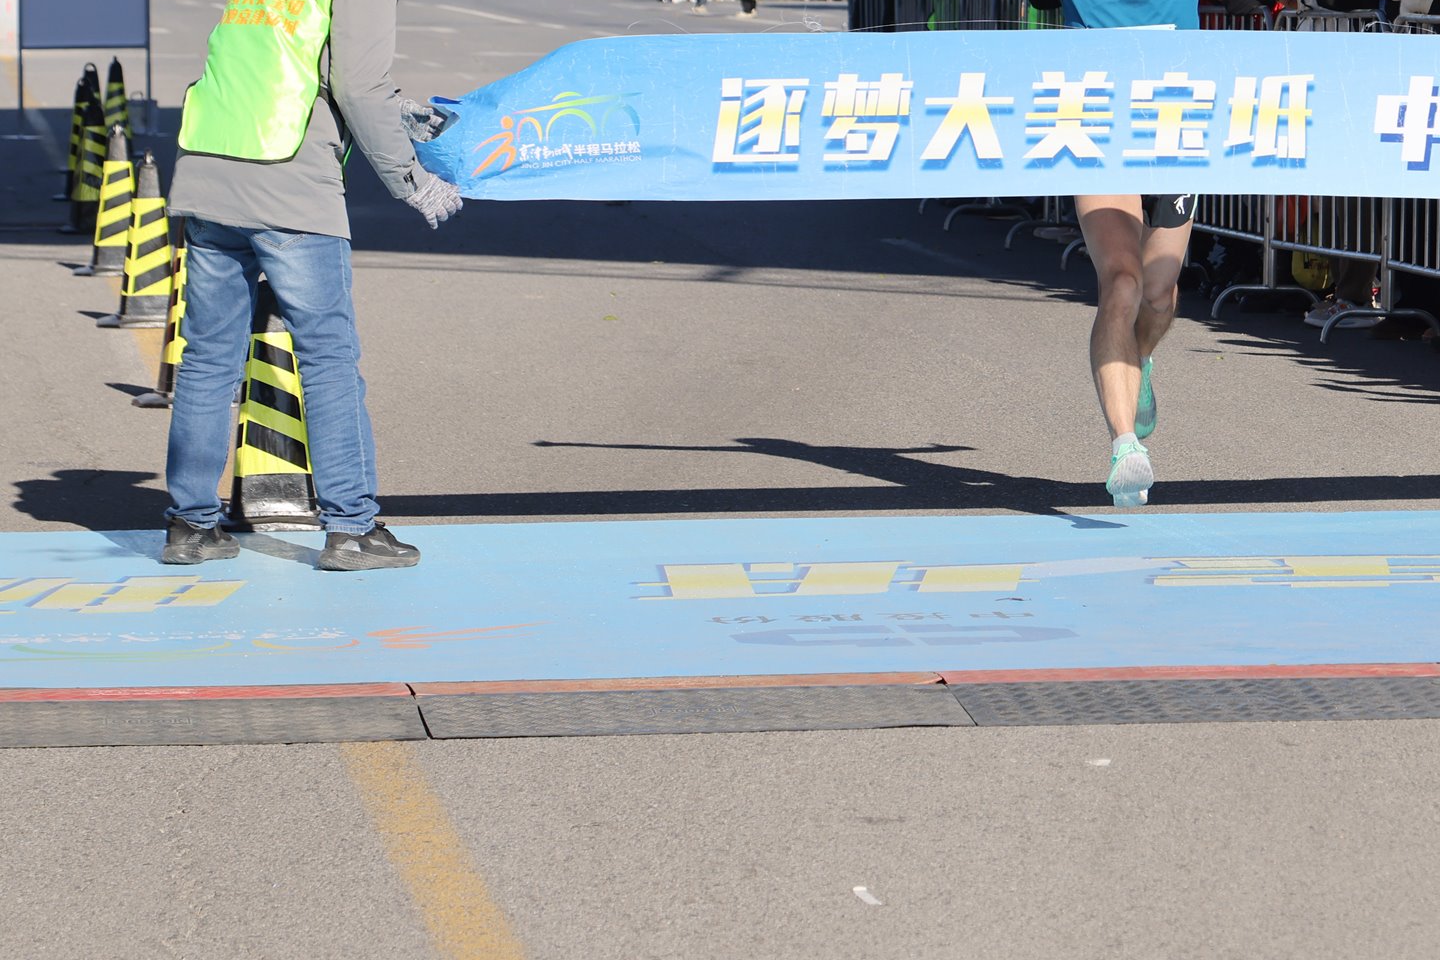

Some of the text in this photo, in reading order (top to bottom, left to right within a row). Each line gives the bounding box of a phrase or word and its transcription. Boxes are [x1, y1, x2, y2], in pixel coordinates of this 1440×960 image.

[712, 71, 1316, 170] 逐梦大美宝坻
[554, 159, 572, 167] CITY
[595, 155, 642, 163] MARATHON
